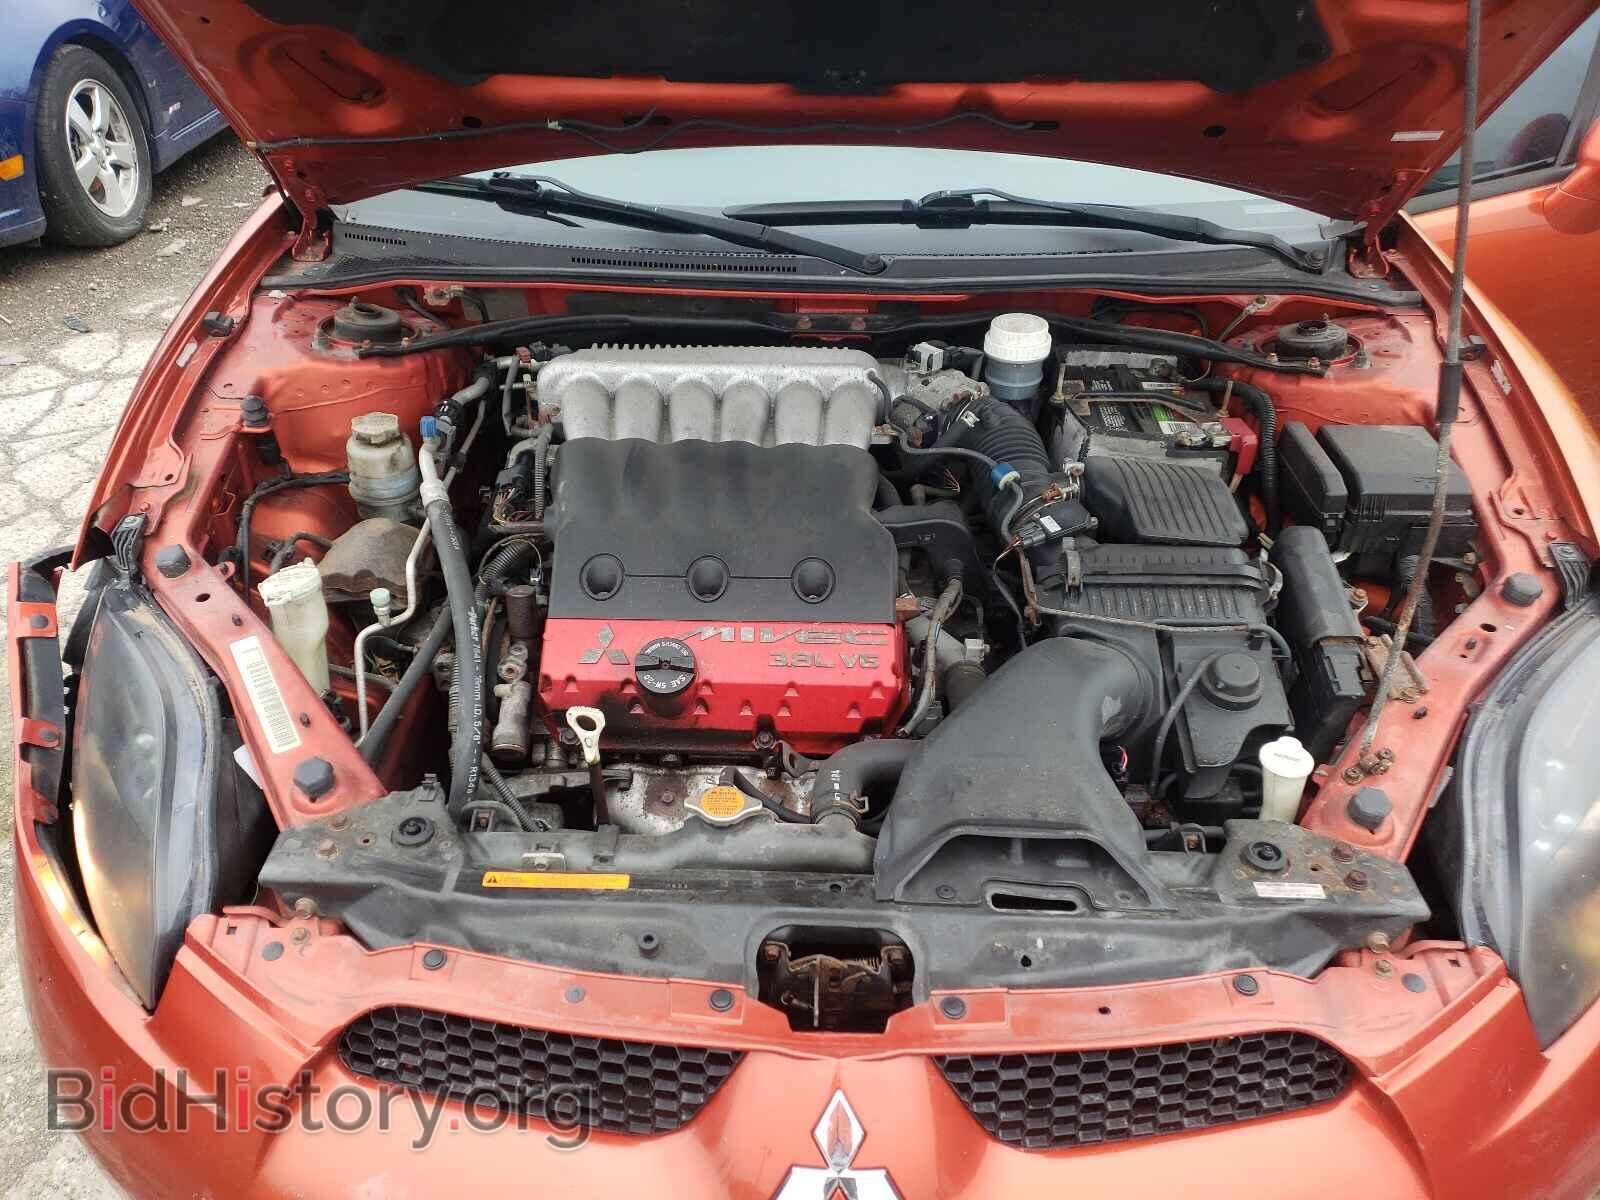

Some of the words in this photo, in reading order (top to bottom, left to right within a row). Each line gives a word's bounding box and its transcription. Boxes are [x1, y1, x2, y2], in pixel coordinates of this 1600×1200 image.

[678, 627, 889, 645] MIVEC
[768, 652, 836, 668] 3.8L
[840, 652, 880, 668] V6
[643, 674, 667, 689] 5W-20
[671, 674, 686, 688] SAE
